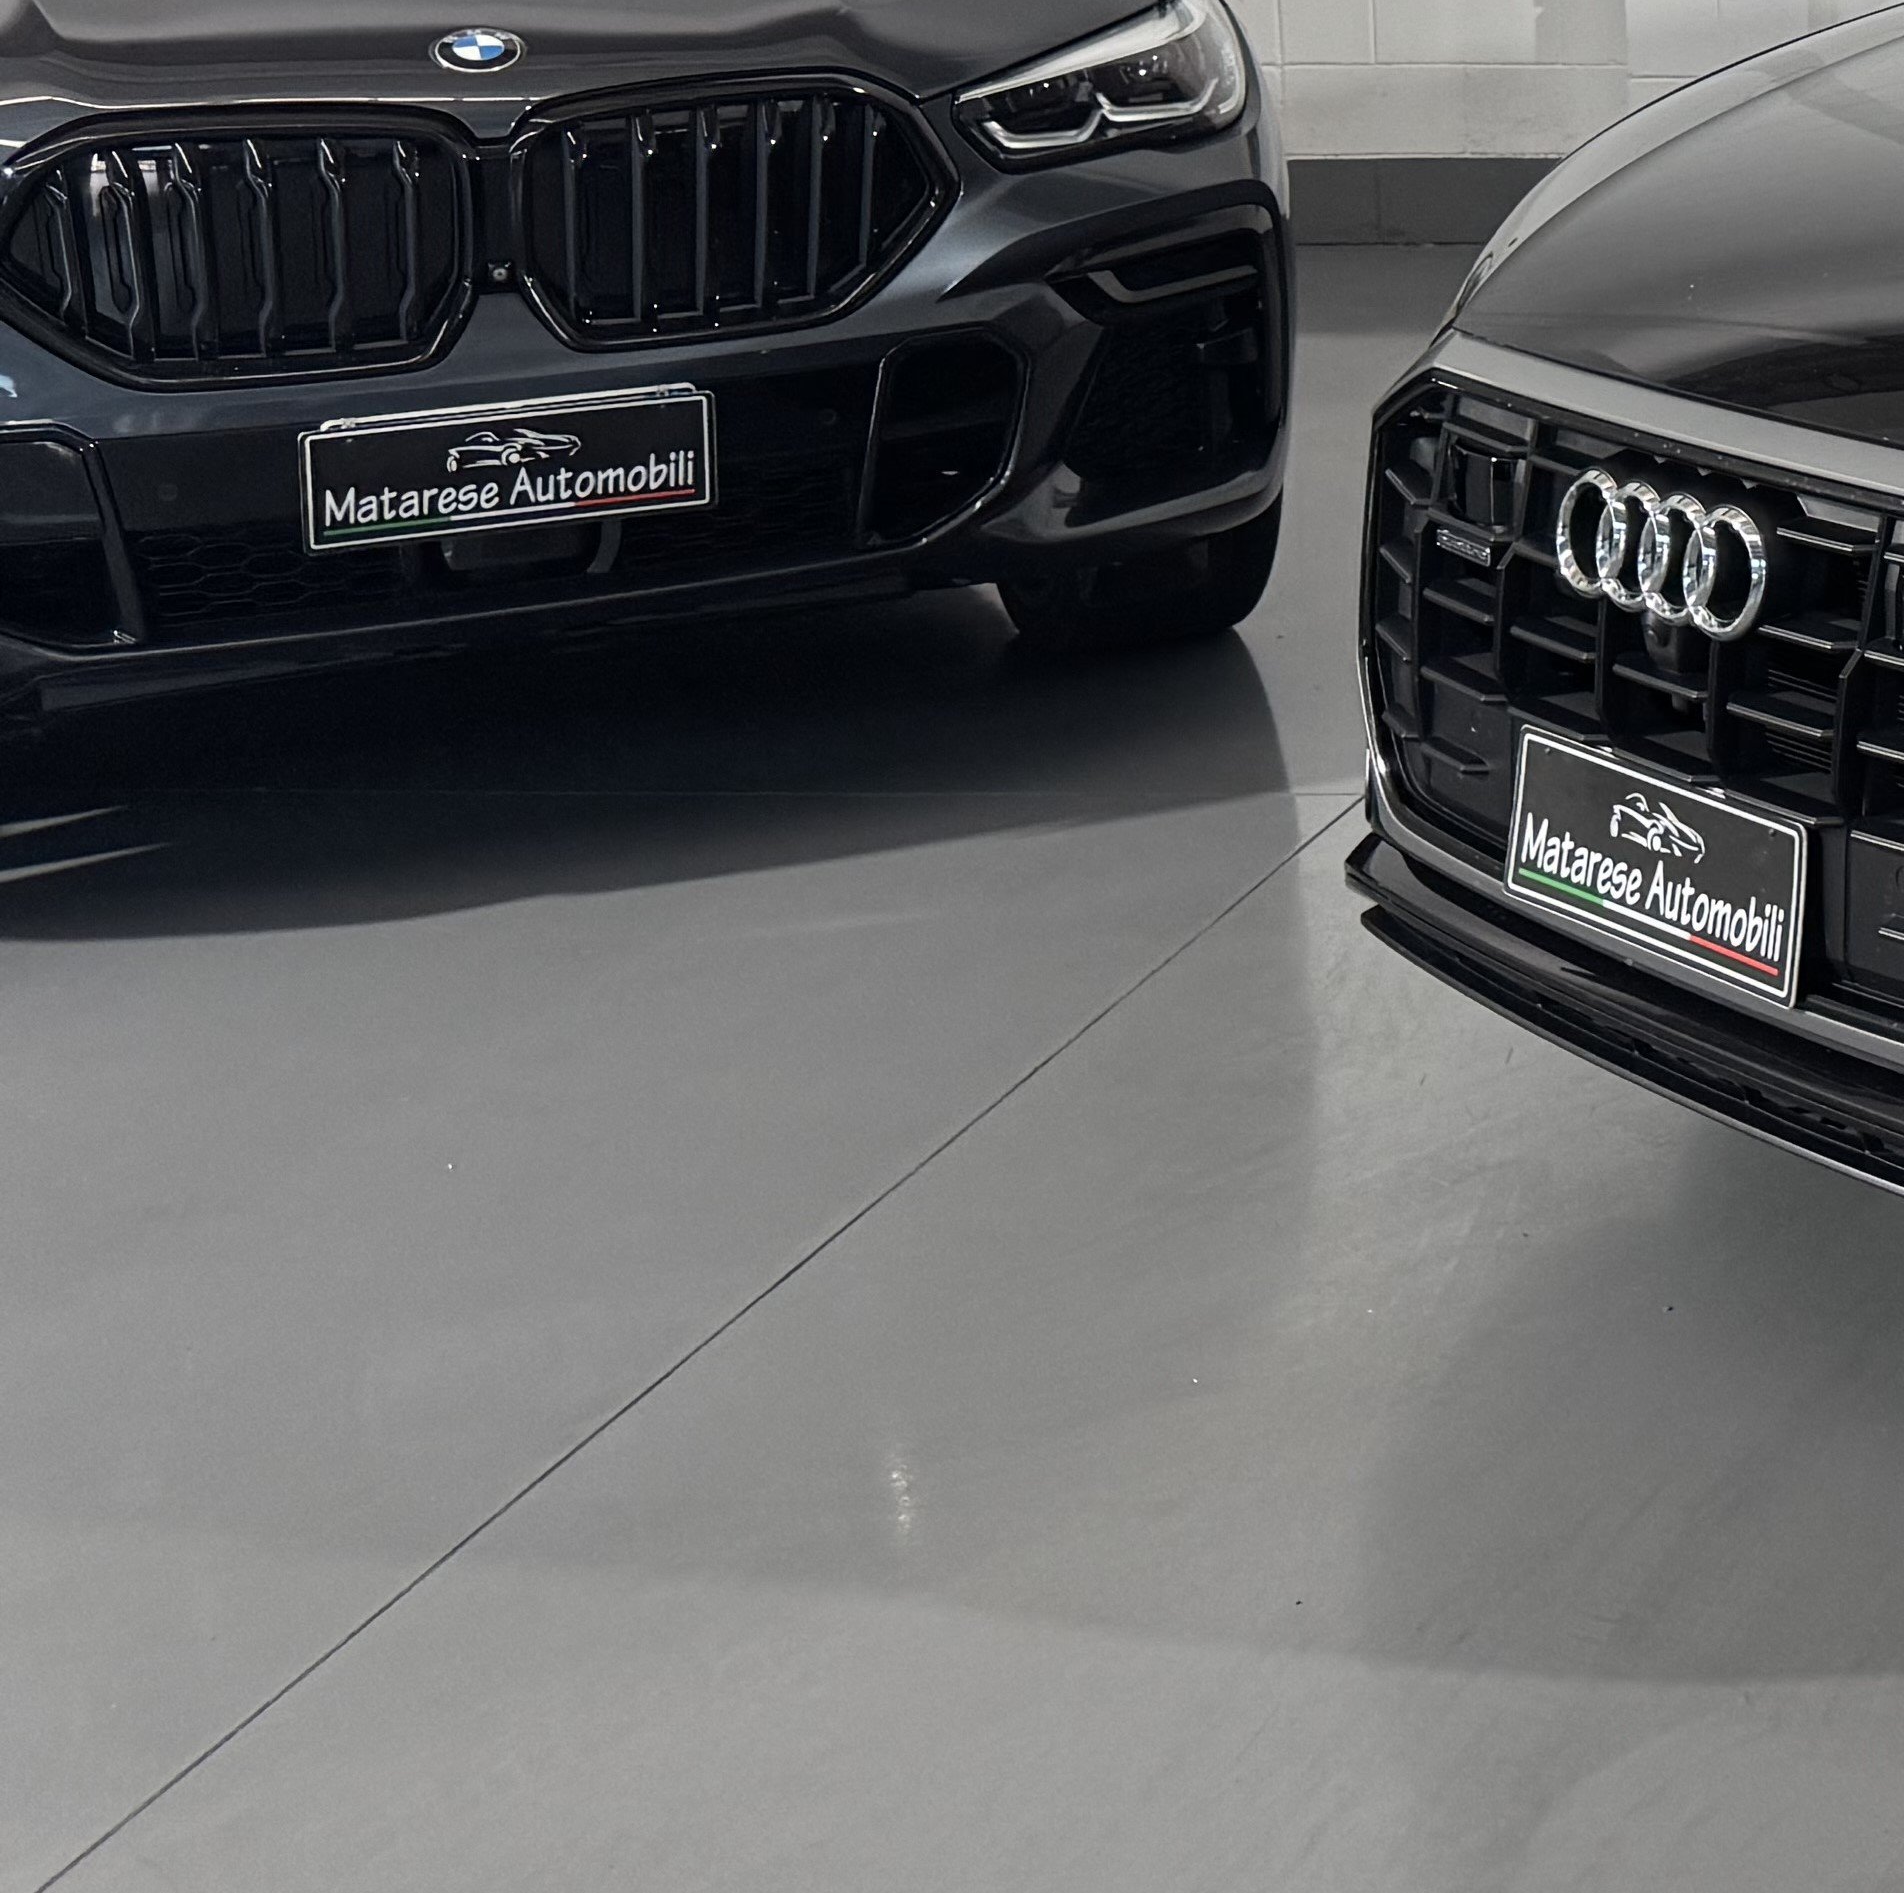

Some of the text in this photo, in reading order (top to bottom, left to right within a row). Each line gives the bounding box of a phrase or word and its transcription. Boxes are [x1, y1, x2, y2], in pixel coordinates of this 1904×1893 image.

[324, 449, 696, 528] Matarese Automobili
[1519, 811, 1786, 963] Matarese Automobili
